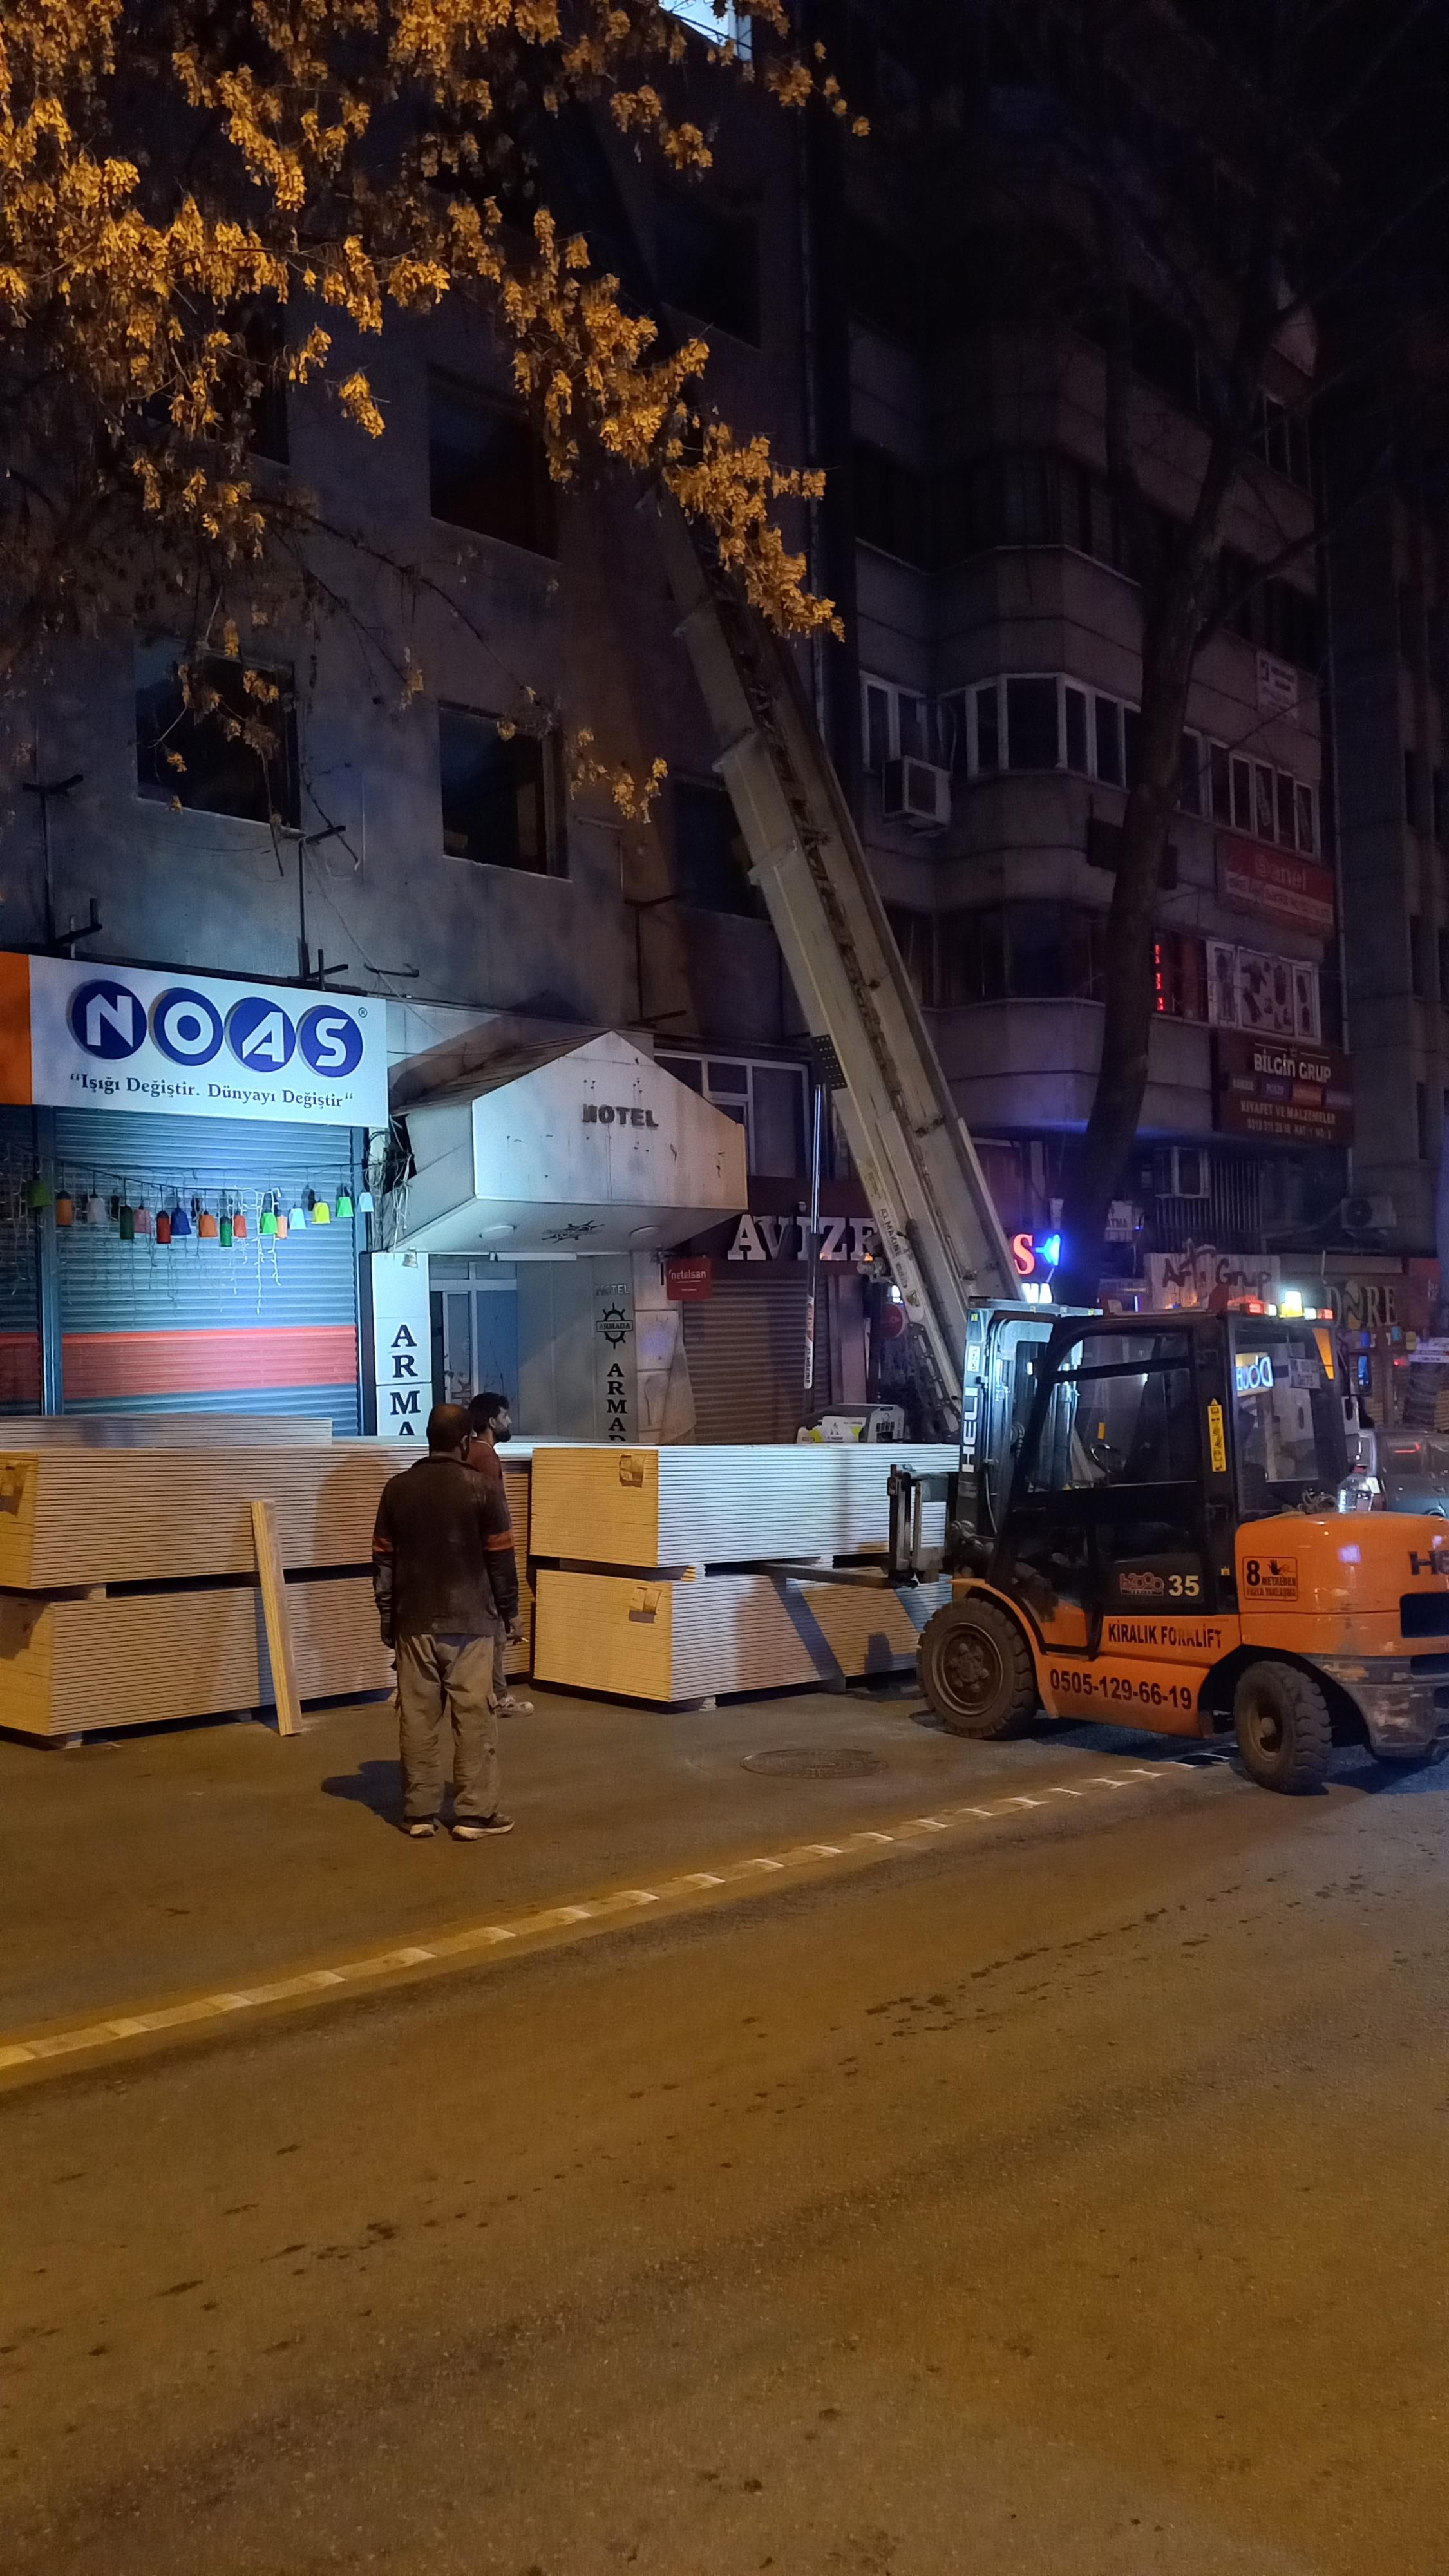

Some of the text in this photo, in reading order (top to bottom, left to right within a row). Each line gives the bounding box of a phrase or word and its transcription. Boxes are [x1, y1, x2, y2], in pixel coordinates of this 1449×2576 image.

[76, 986, 356, 1072] NOAS
[1298, 1062, 1331, 1083] GRUP
[126, 1077, 200, 1098] Değiştir.
[207, 1083, 276, 1105] Dünyayı
[582, 1104, 659, 1128] HOTEL
[1240, 1100, 1273, 1116] KIYAFET
[1275, 1105, 1285, 1118] VE
[595, 1283, 630, 1296] HOTEL
[599, 1322, 631, 1331] ARMADA
[961, 1387, 978, 1473] HELI
[1247, 1560, 1260, 1586] 8
[1168, 1575, 1200, 1596] 35
[1108, 1620, 1158, 1645] KİRALIK
[1050, 1669, 1191, 1710] 0505-129-66-19
